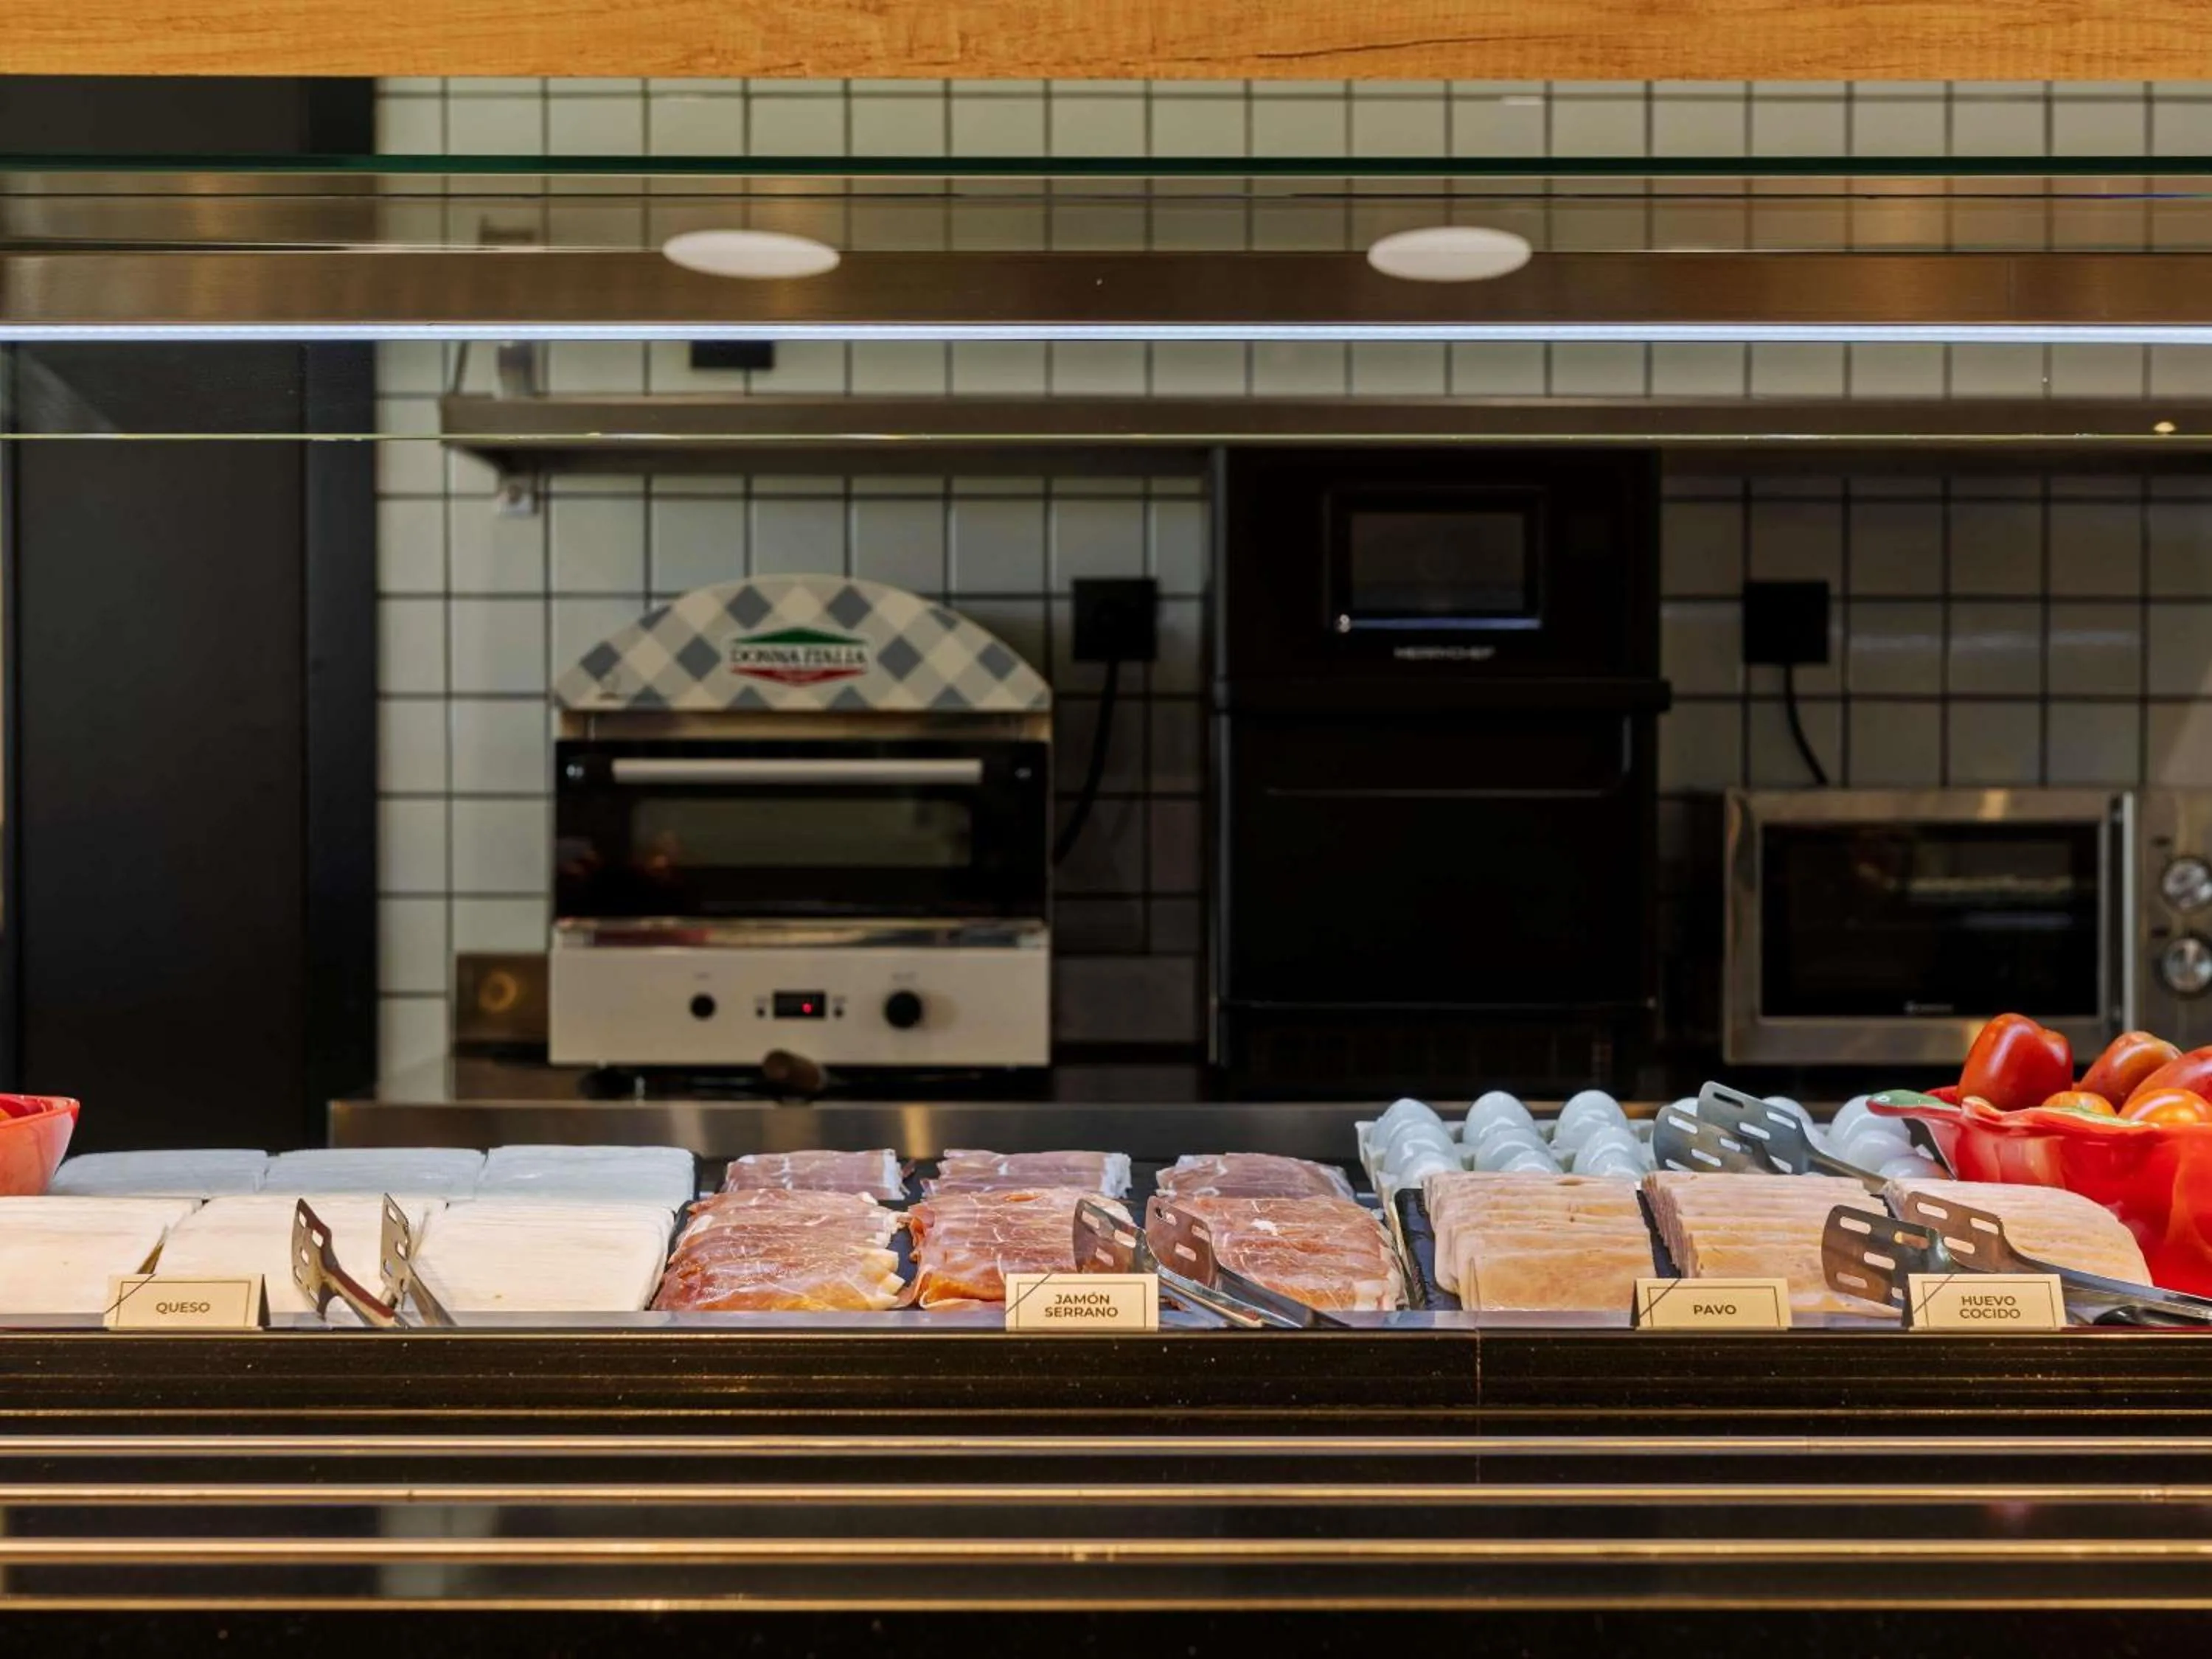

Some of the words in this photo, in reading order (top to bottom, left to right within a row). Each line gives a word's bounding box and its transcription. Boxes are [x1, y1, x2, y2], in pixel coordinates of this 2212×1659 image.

[1054, 1292, 1110, 1304] JAMÓN
[1961, 1295, 2017, 1306] HUEVO
[156, 1301, 211, 1314] QUESO
[1044, 1306, 1119, 1318] SERRANO
[1693, 1304, 1737, 1315] PAVO
[1959, 1308, 2021, 1319] COCIDO
